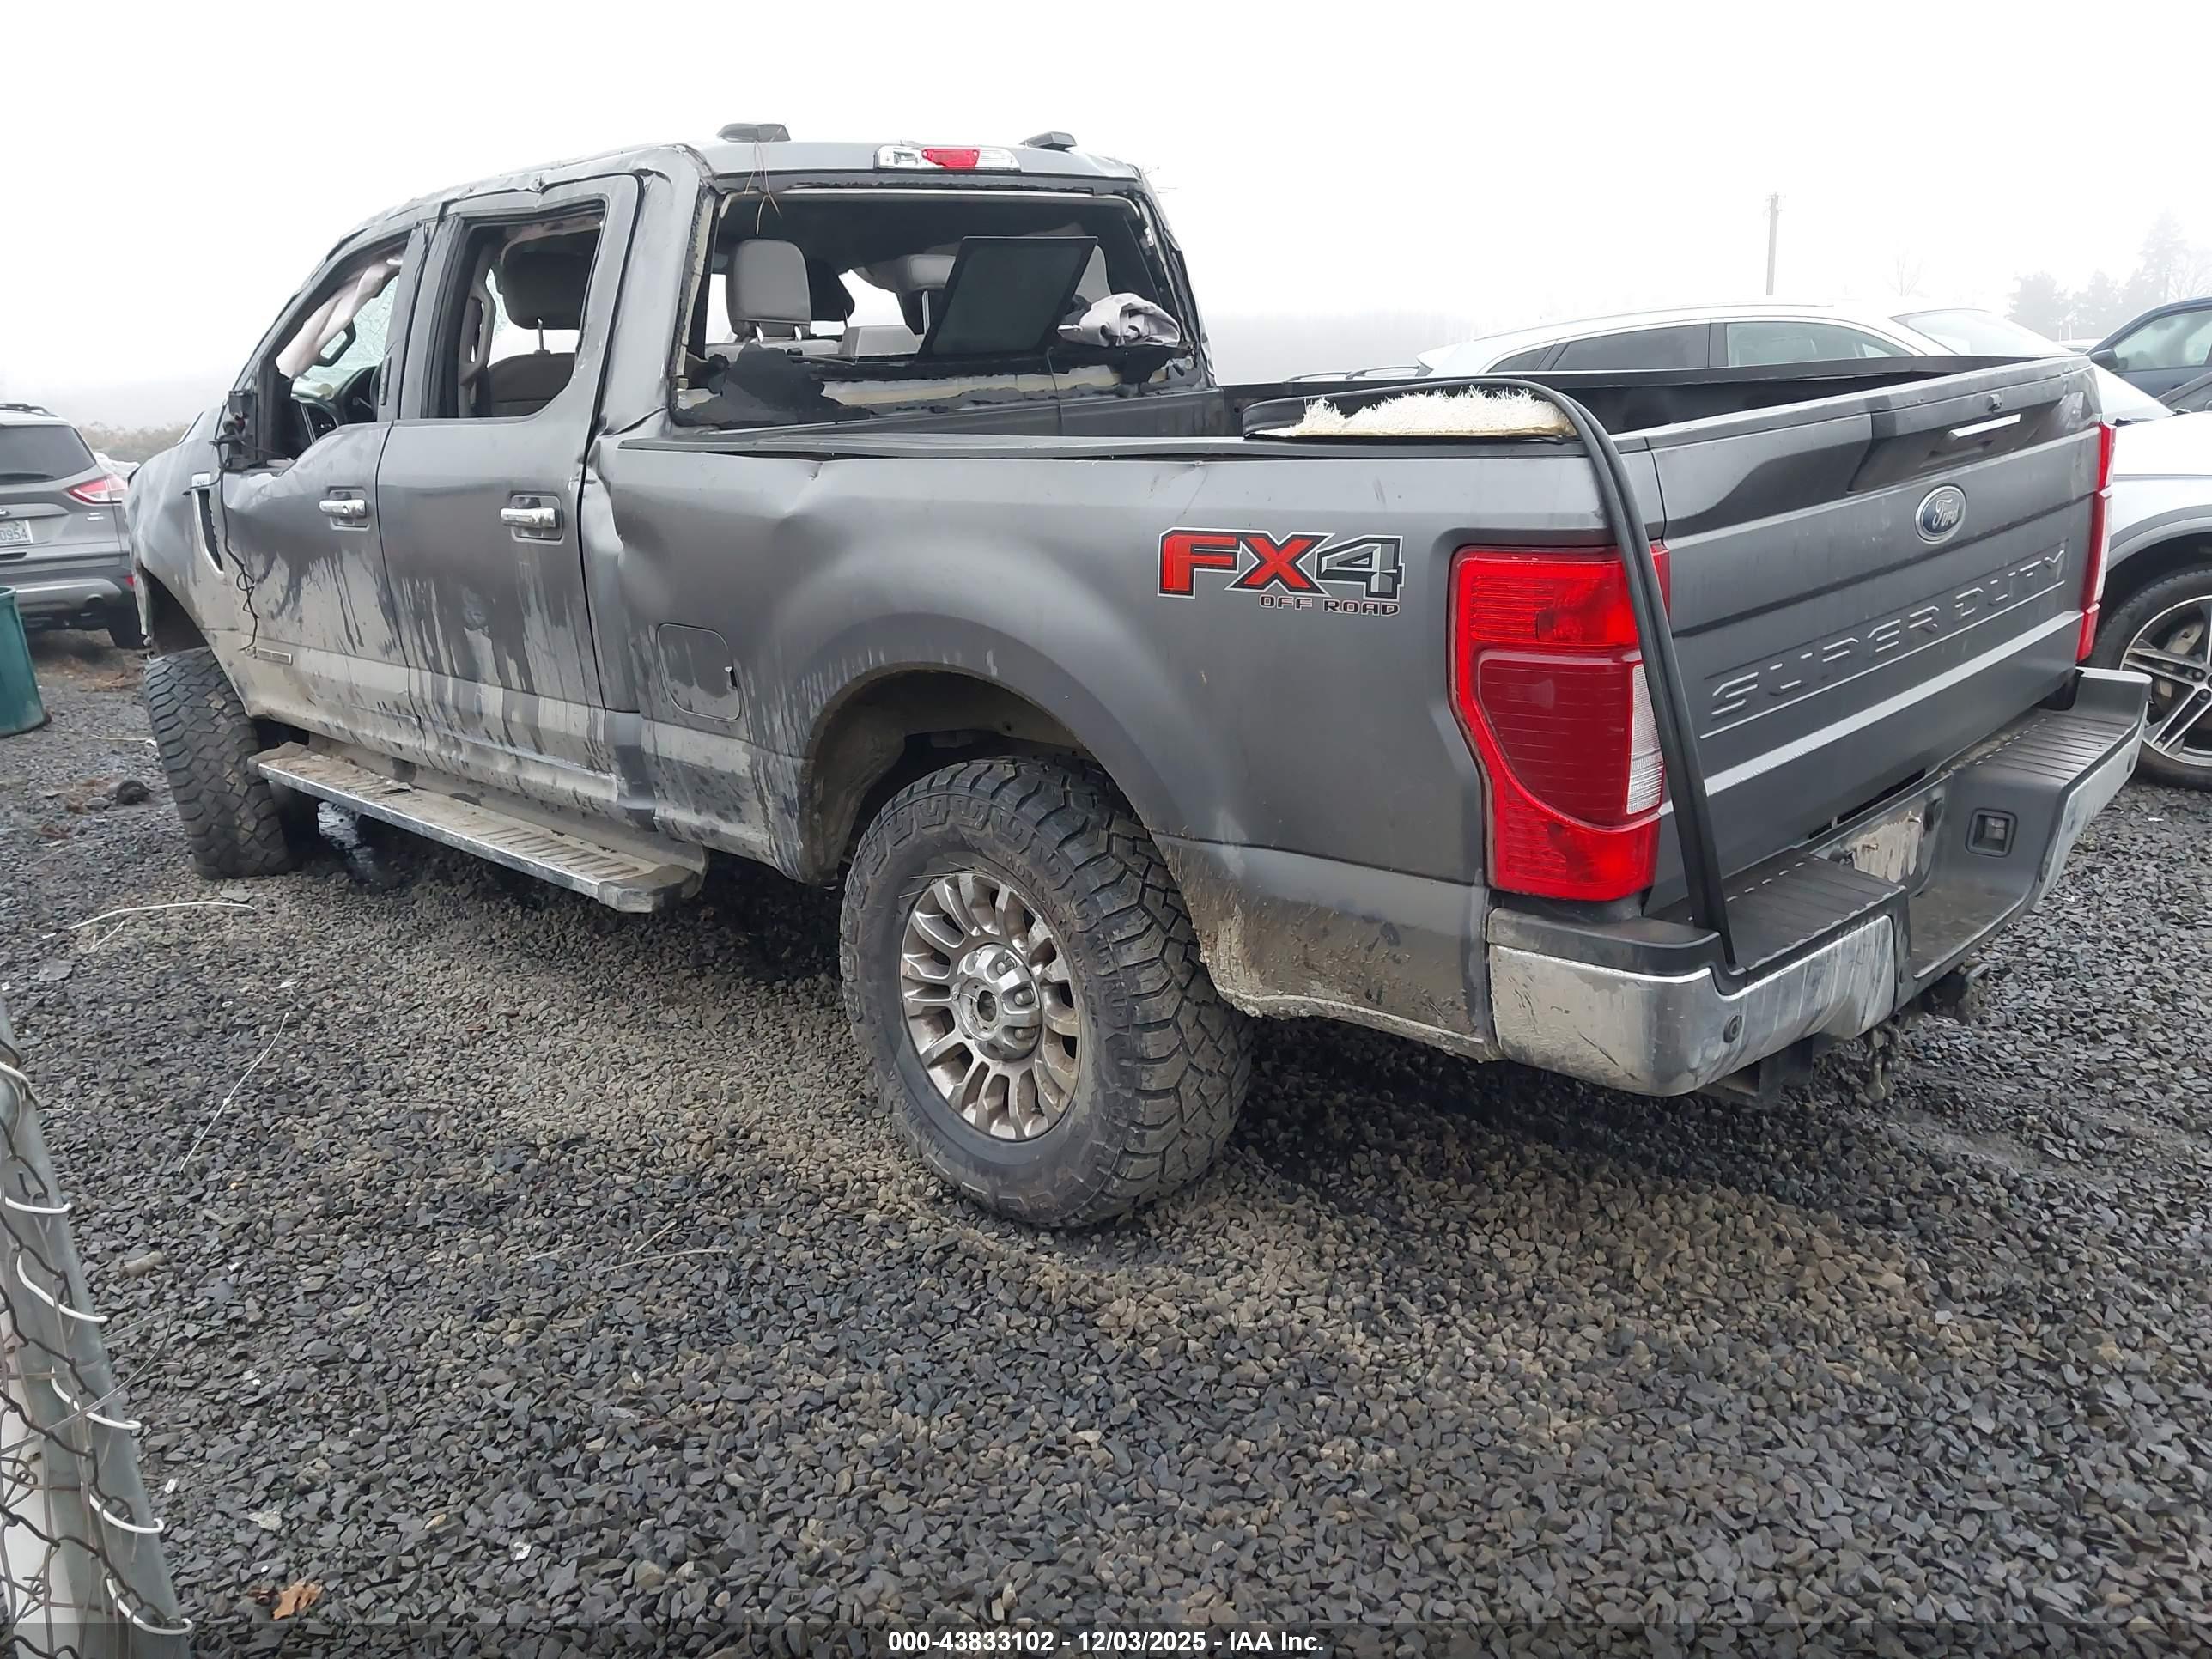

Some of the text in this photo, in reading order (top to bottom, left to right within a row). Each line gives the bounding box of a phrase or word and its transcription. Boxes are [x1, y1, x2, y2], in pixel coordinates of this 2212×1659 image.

[1931, 497, 1960, 529] Ford
[1158, 527, 1405, 600] FX4
[1259, 594, 1401, 617] OFF ROAD
[1710, 550, 2065, 720] SUPER DUTY
